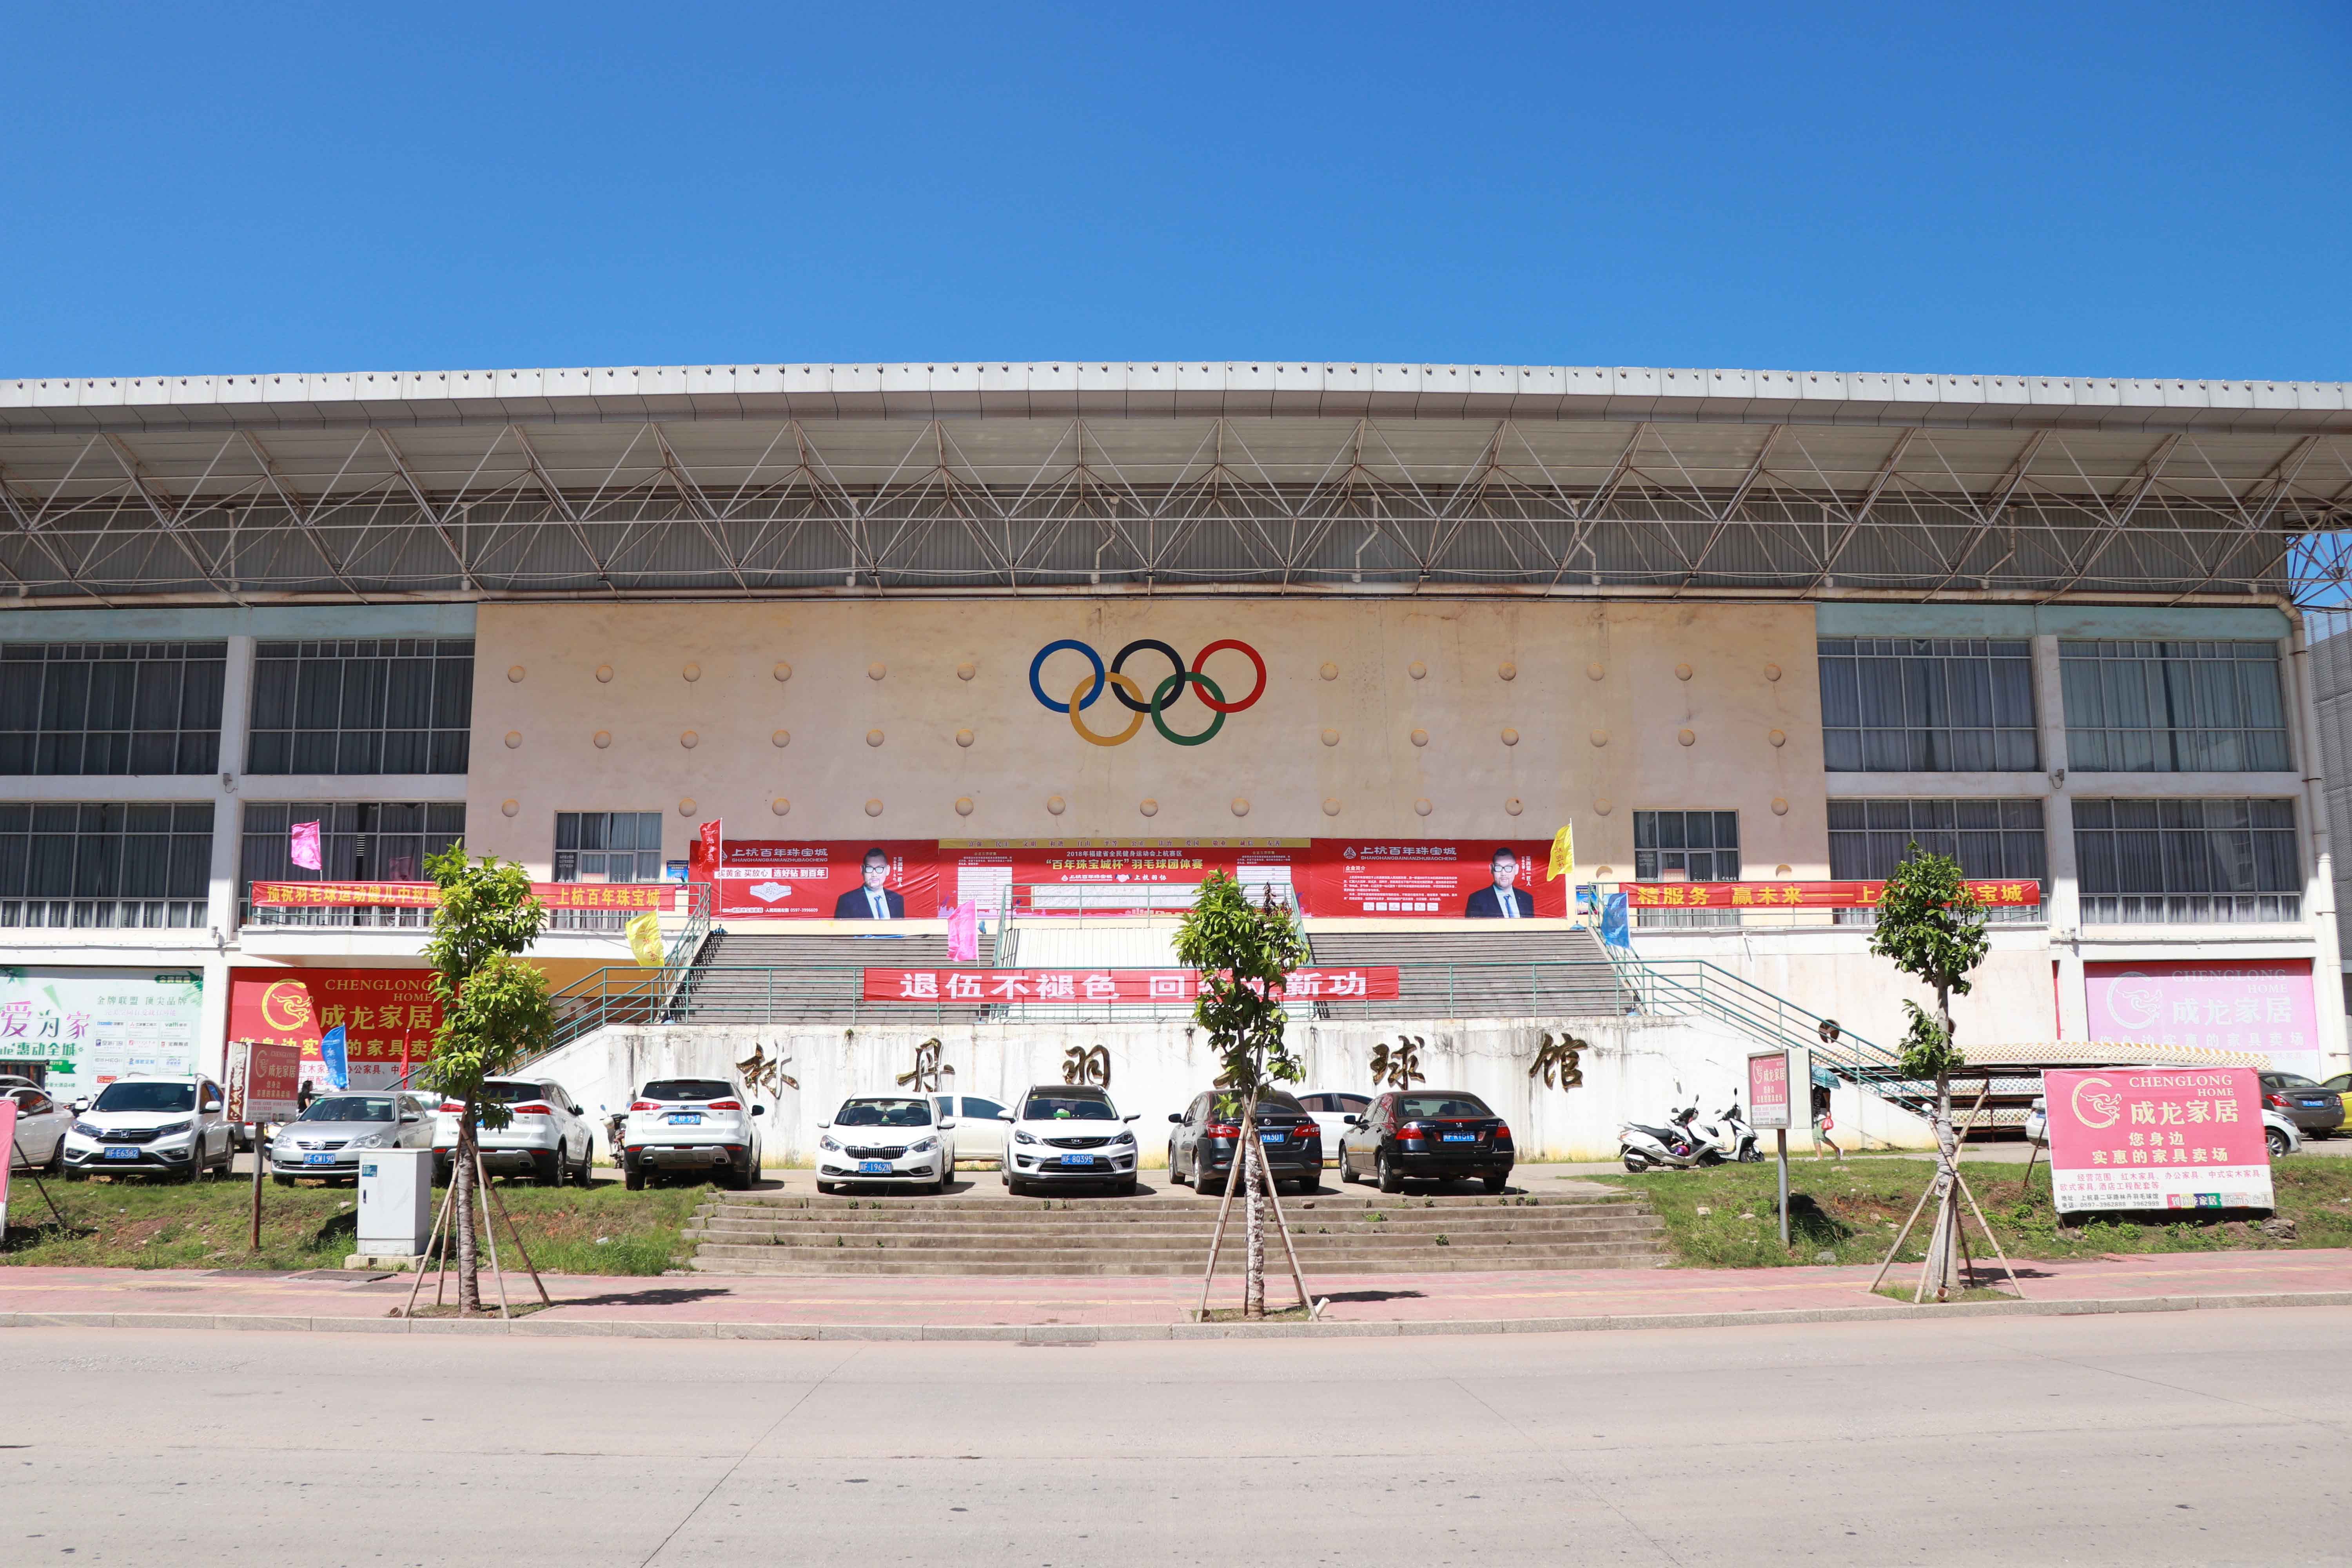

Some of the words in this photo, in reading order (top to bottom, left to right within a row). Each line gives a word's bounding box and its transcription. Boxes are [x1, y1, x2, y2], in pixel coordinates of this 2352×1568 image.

[731, 848, 828, 857] 上杭百年珠宝城
[1360, 846, 1457, 855] 上杭百年珠宝城
[718, 868, 742, 877] 买黄金
[744, 868, 768, 877] 买放心
[773, 868, 799, 878] 选好钻
[800, 868, 826, 878] 到百年
[2172, 969, 2287, 982] CHENGLONG
[900, 973, 1120, 999] 退伍不褪色
[2247, 984, 2288, 994] HOME
[97, 996, 138, 1005] 金牌联盟
[145, 996, 188, 1005] 顶尖品牌
[394, 993, 432, 1002] HOME
[320, 1004, 433, 1030] 成龙家居
[2173, 997, 2292, 1025] 成龙家居
[16, 1042, 76, 1056] 惠动全城
[268, 1065, 296, 1078] 成龙家居
[736, 1033, 1589, 1099] 林丹羽球馆
[1764, 1067, 1785, 1082] 成龙家居
[2129, 1075, 2233, 1088] CHENGLONG
[2198, 1087, 2234, 1096] HOME
[2131, 1099, 2239, 1125] 成龙家居
[2129, 1132, 2185, 1146] 您身边
[2091, 1147, 2228, 1165] 实惠的家具卖场
